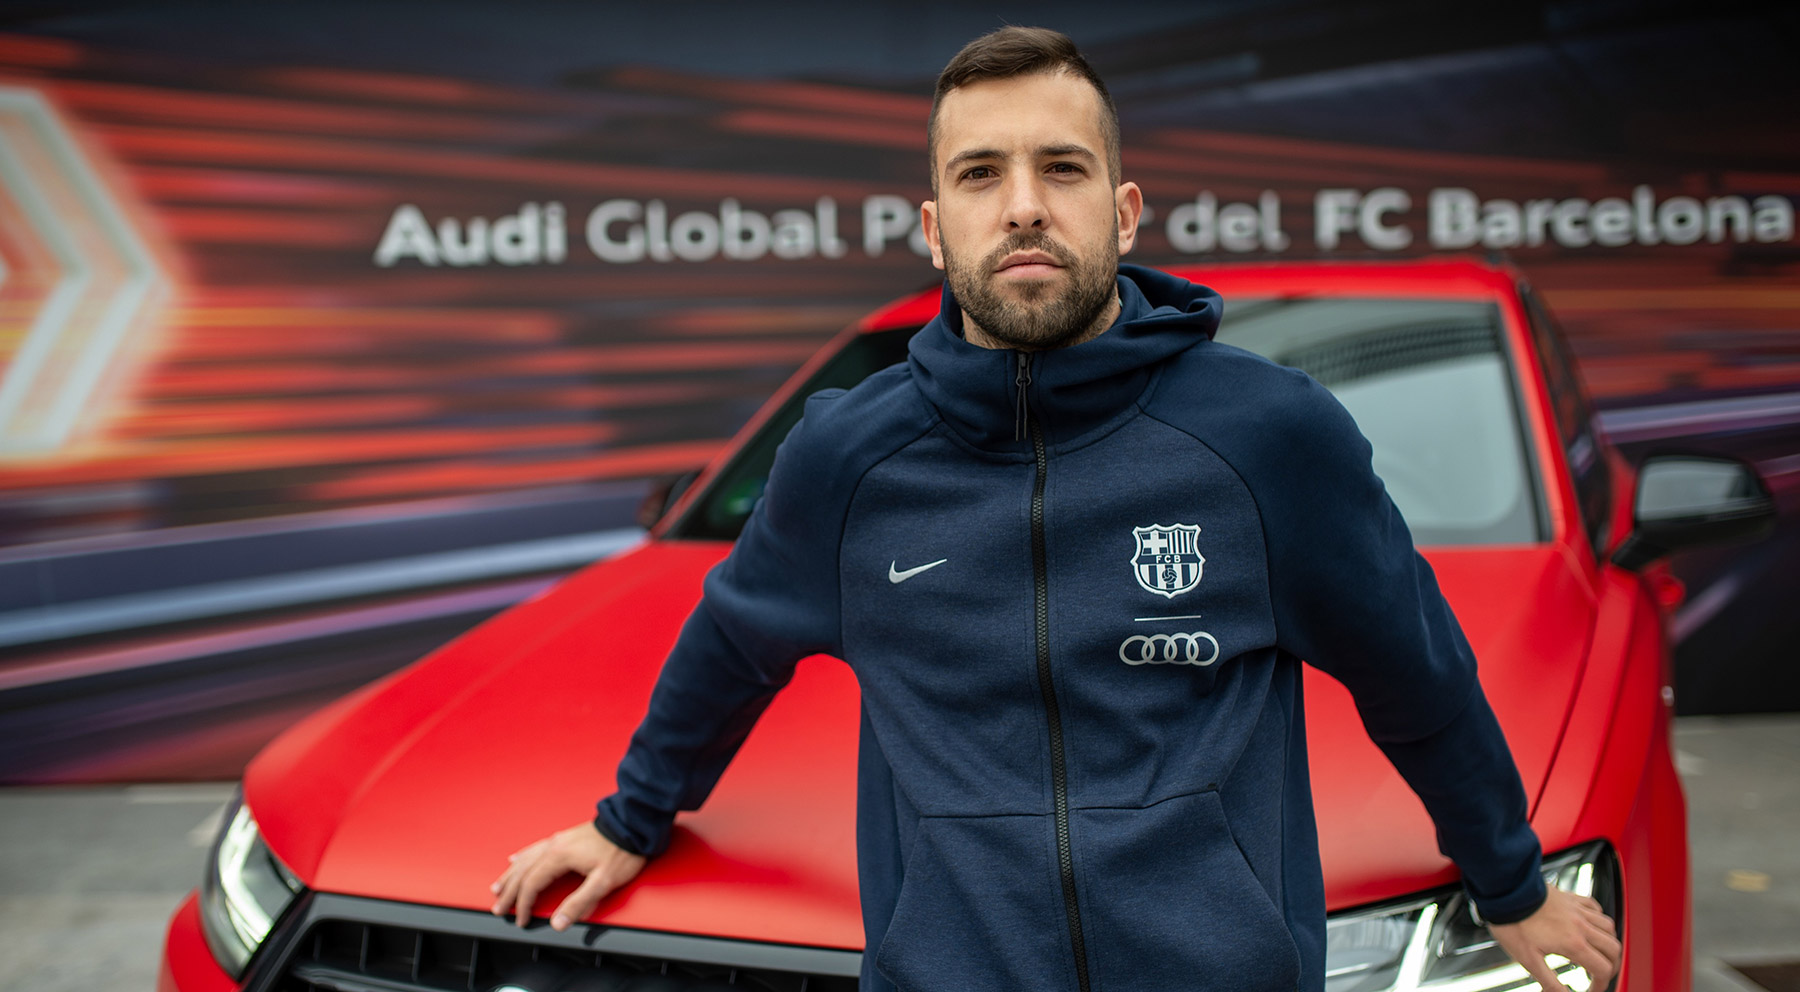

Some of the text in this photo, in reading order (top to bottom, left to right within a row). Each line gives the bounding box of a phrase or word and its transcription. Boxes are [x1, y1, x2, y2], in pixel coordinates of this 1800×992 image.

[375, 202, 568, 266] Audi
[585, 197, 847, 263] Global
[1165, 190, 1288, 252] del
[1315, 188, 1413, 250] FC
[1428, 185, 1791, 249] Barcelona
[1156, 554, 1181, 564] FCB
